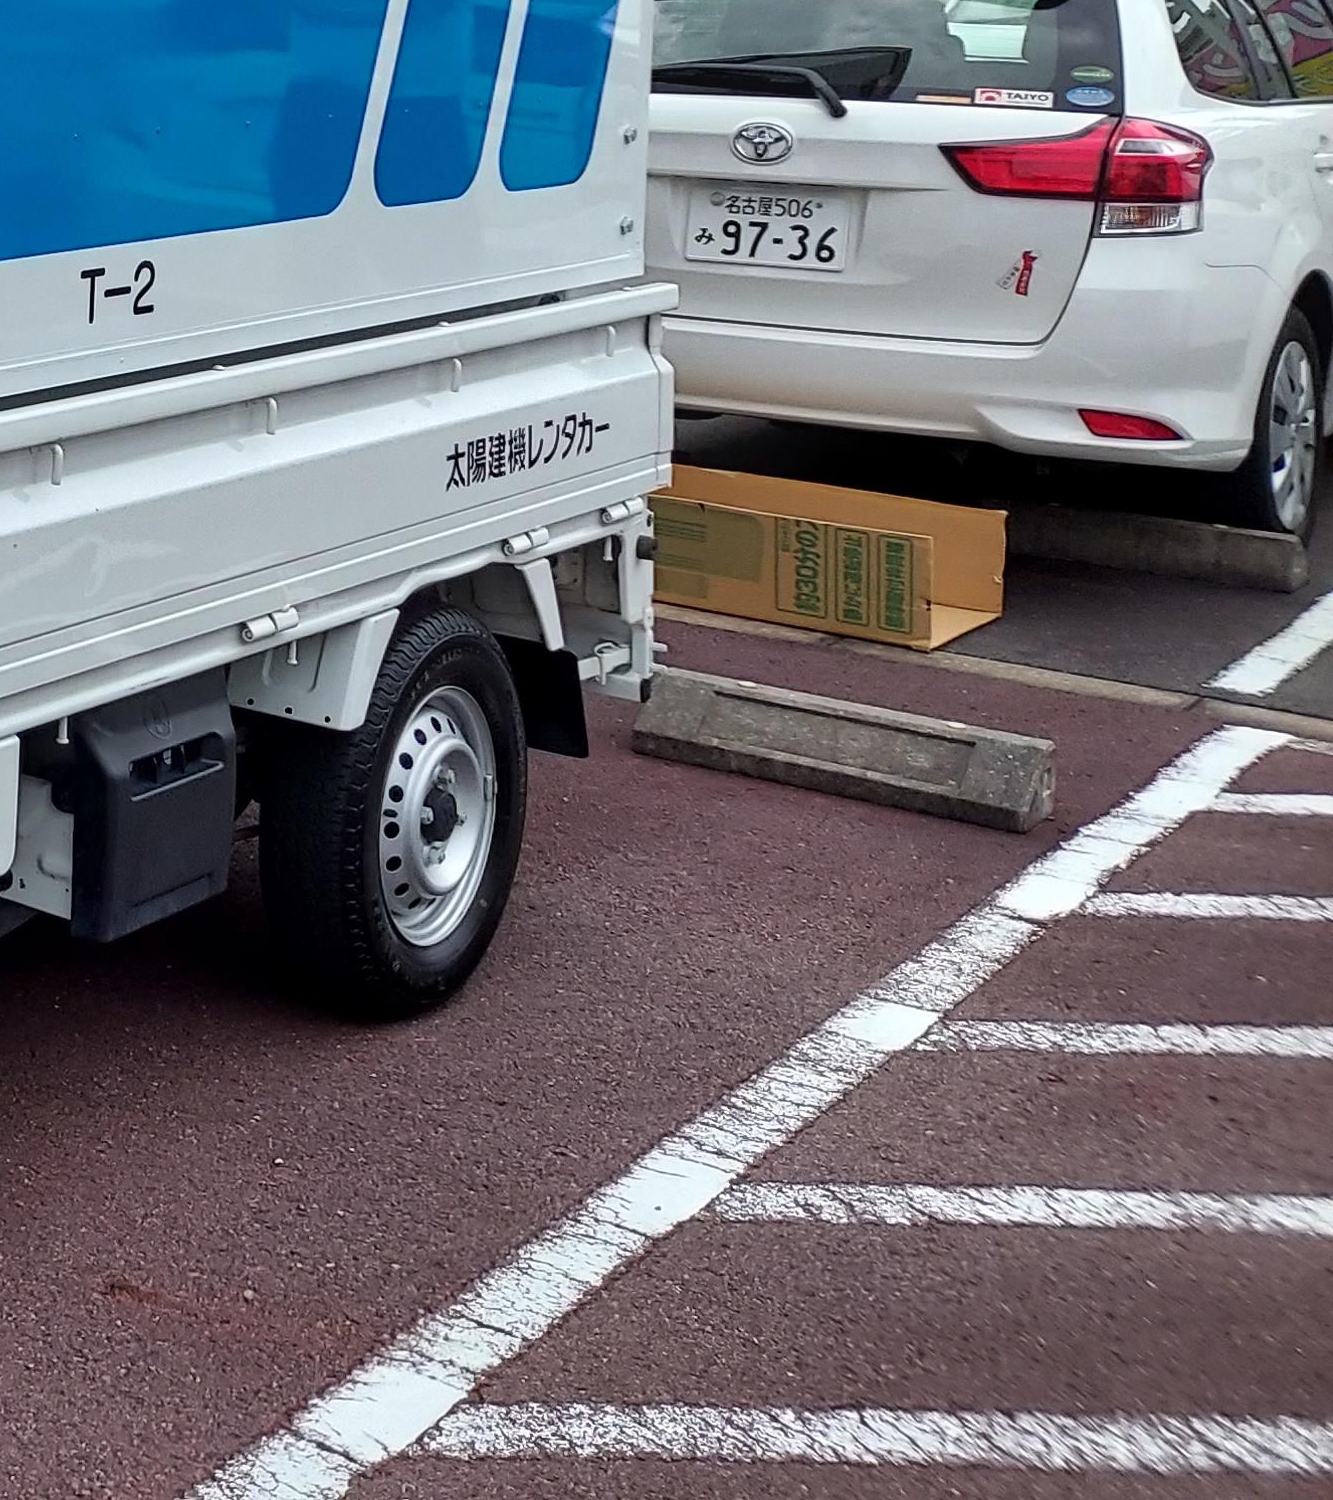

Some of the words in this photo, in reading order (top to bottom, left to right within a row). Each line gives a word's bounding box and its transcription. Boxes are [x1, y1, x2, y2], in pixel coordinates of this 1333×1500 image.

[1006, 91, 1049, 102] TAIYO
[694, 228, 715, 245] み
[720, 220, 838, 262] 97-36
[80, 260, 156, 324] T-2
[445, 412, 610, 491] 太陽建機レンタカー
